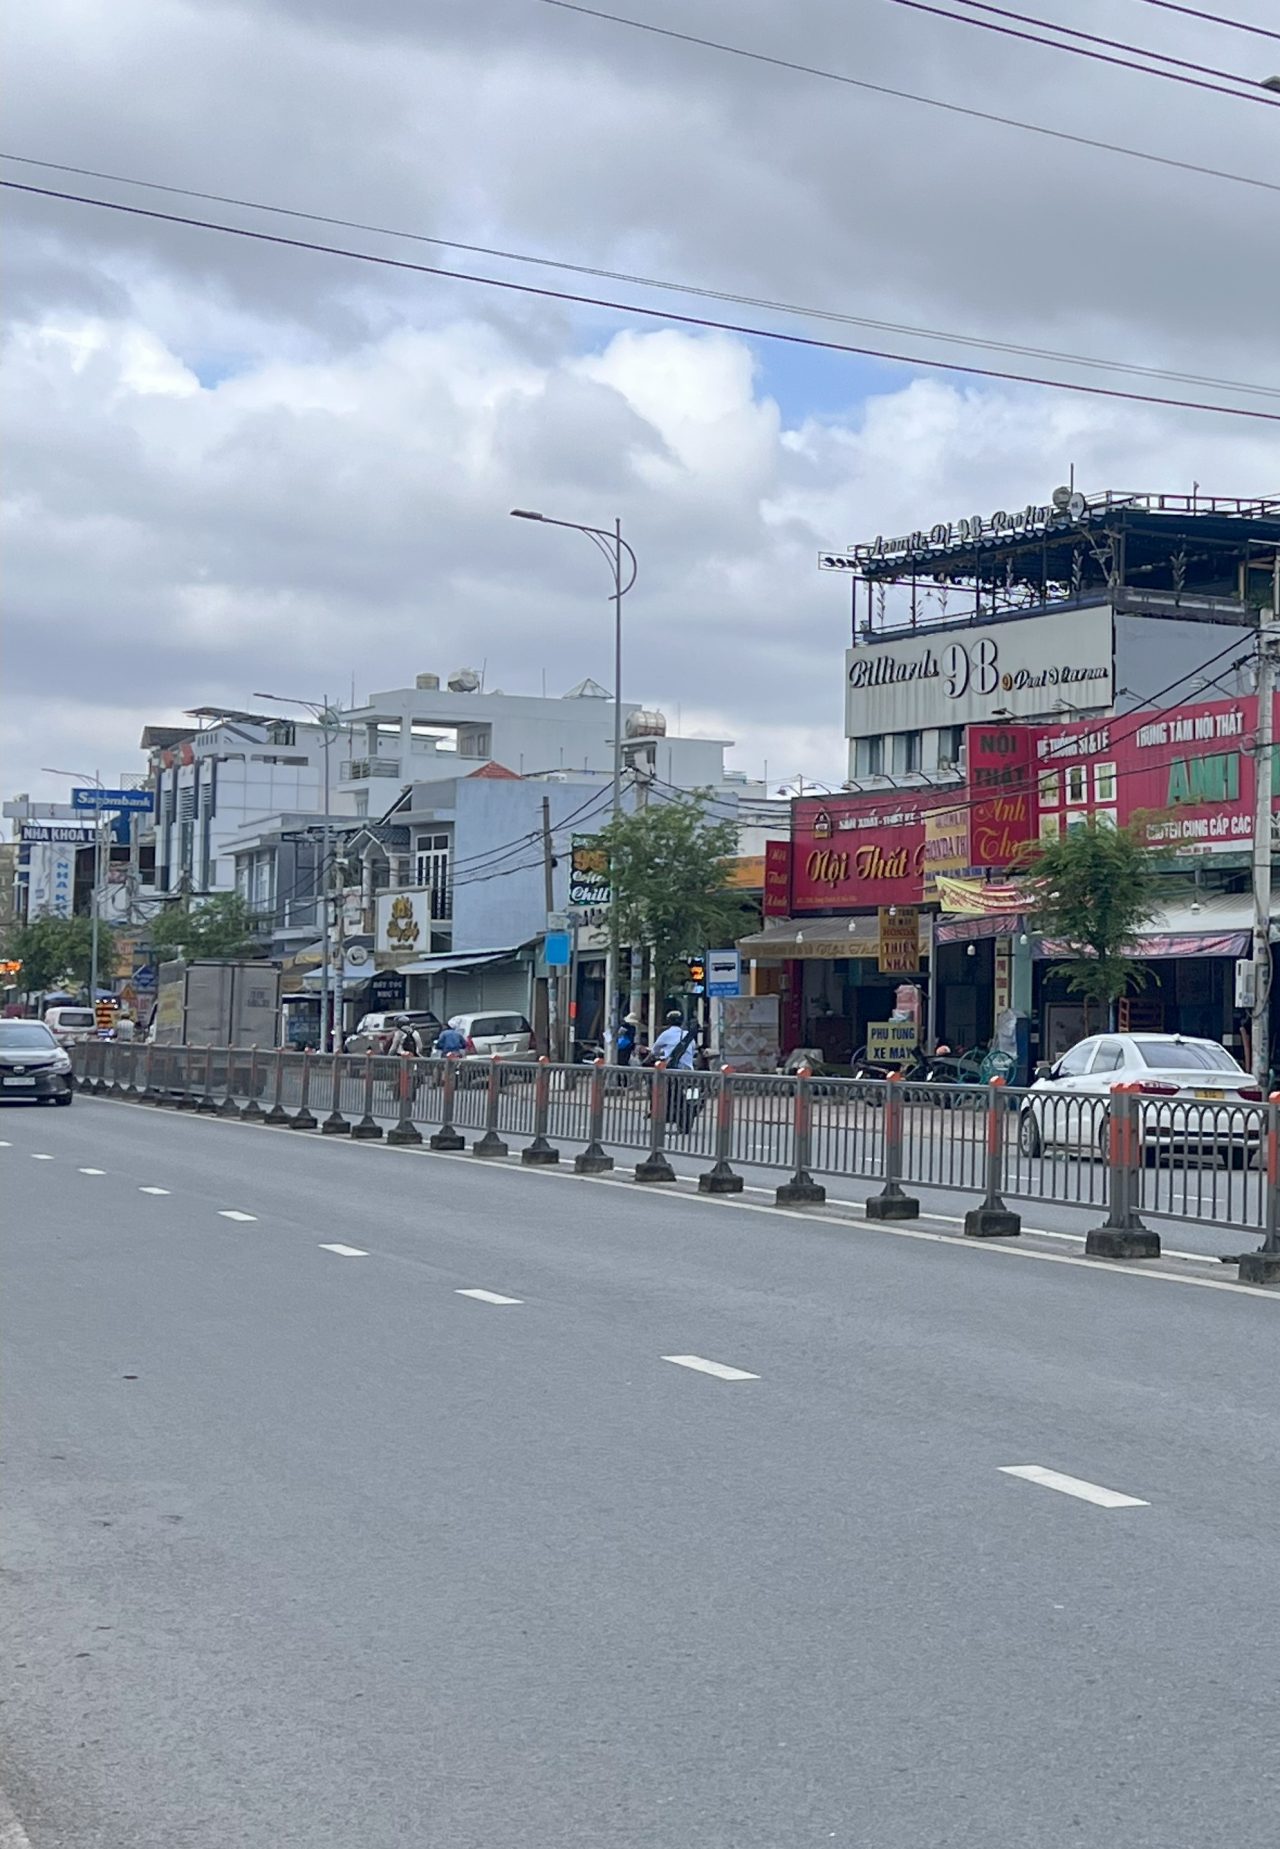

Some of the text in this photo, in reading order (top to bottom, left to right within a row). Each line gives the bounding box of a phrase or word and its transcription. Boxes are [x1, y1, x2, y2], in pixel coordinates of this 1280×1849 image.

[848, 649, 940, 688] Billiards
[942, 638, 998, 698] 98
[1014, 669, 1048, 690] Pool
[1169, 715, 1194, 743] TÂM
[1195, 712, 1213, 742] NỘI
[1216, 705, 1244, 737] THẤT
[980, 731, 1017, 757] NỘI
[975, 763, 1025, 788] THẤT
[1168, 751, 1241, 805] ANH
[77, 791, 151, 808] Sacombank
[23, 827, 48, 840] NHA
[51, 828, 85, 841] KHOA
[1182, 816, 1208, 838] CUNG
[1209, 812, 1229, 836] CẤP
[1231, 815, 1252, 834] CÁC
[805, 849, 849, 889] Nội
[856, 844, 909, 880] Thất
[571, 886, 610, 902] Chill
[873, 1047, 887, 1060] XE
